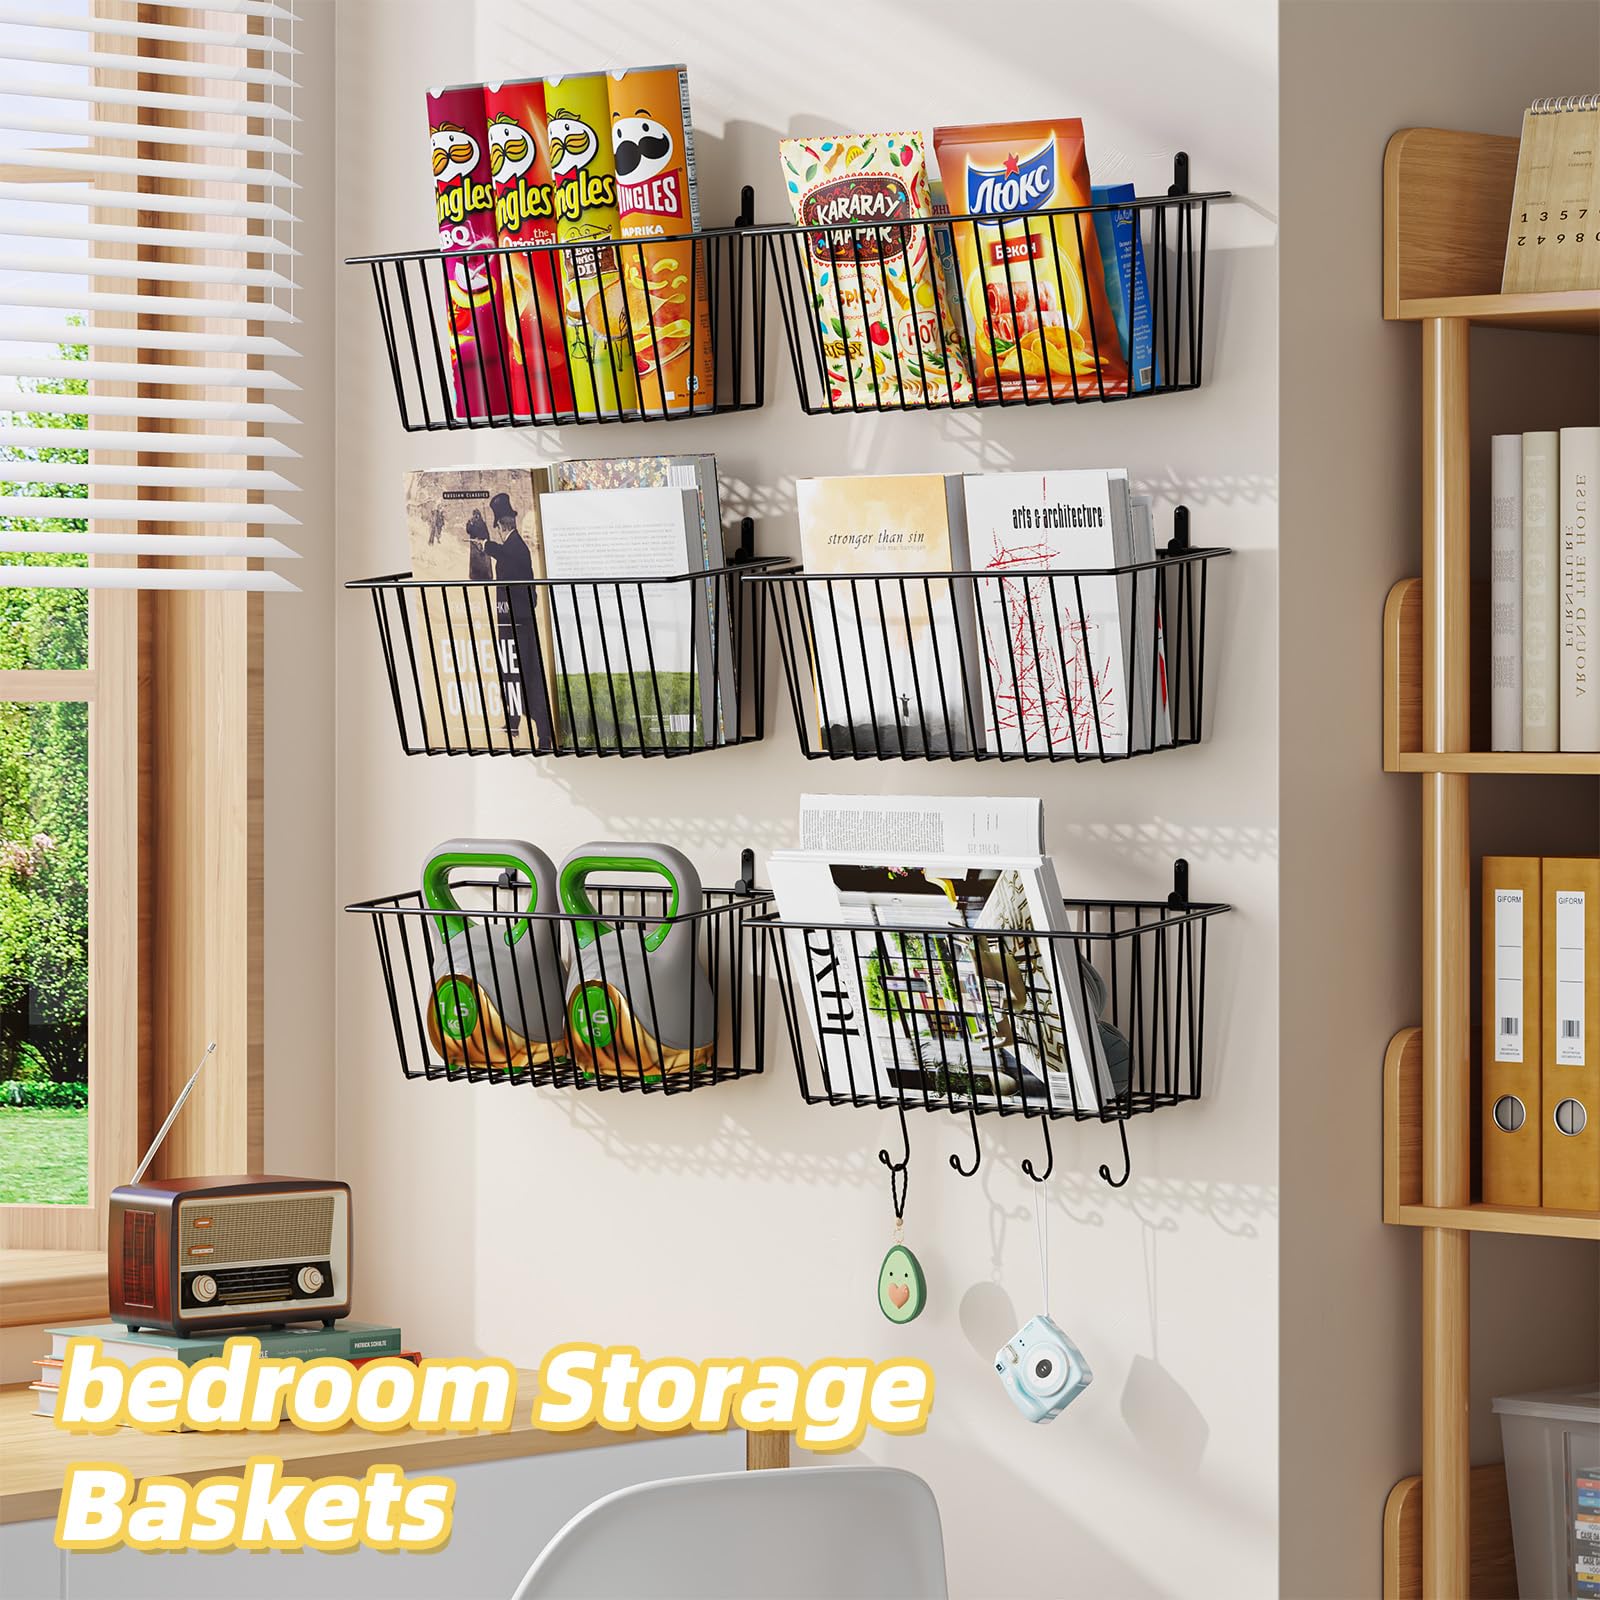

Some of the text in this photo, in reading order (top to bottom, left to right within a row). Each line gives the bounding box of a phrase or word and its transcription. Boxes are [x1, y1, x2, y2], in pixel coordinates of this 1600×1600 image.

[437, 178, 493, 222] ngles
[816, 193, 900, 226] KARARAY
[533, 228, 549, 239] the
[1012, 505, 1032, 529] arts
[1043, 502, 1103, 529] architecture
[827, 534, 874, 550] stronger
[878, 529, 903, 543] than
[908, 531, 925, 543] sin
[447, 681, 522, 716] ONGN
